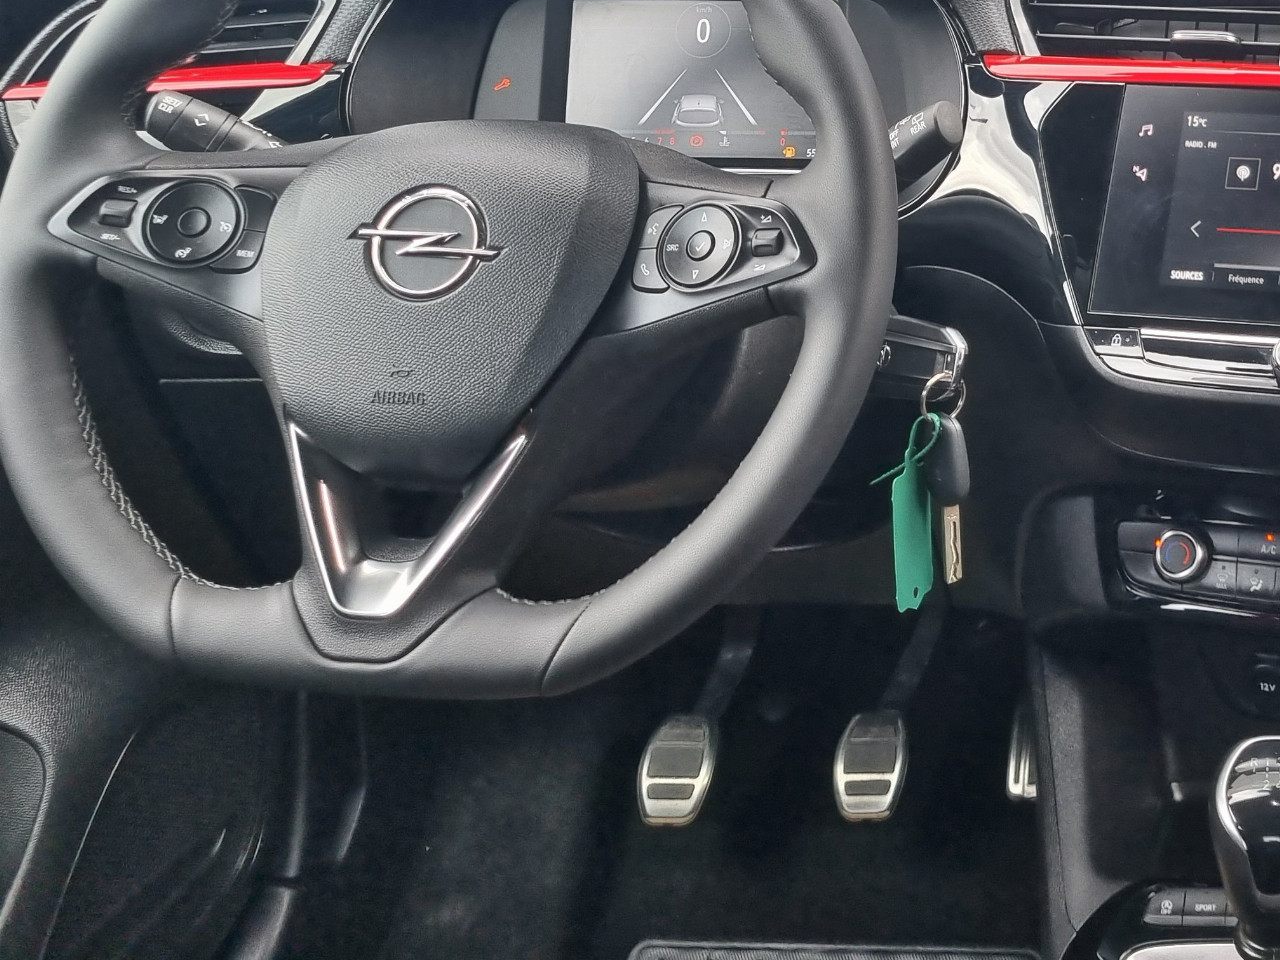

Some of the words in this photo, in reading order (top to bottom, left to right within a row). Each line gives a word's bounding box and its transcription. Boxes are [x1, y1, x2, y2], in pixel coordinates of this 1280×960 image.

[696, 18, 710, 43] 0
[909, 120, 927, 136] REAR
[1185, 140, 1203, 149] RADIO
[1207, 141, 1217, 149] FM
[236, 249, 254, 258] MEM
[666, 244, 679, 252] SRC
[1170, 269, 1204, 281] SOURCES
[1228, 272, 1264, 286] Fréquence
[371, 391, 426, 406] AIRBAG
[1260, 544, 1277, 555] A/C
[1260, 681, 1276, 692] 12V
[1194, 904, 1217, 912] SPORT
